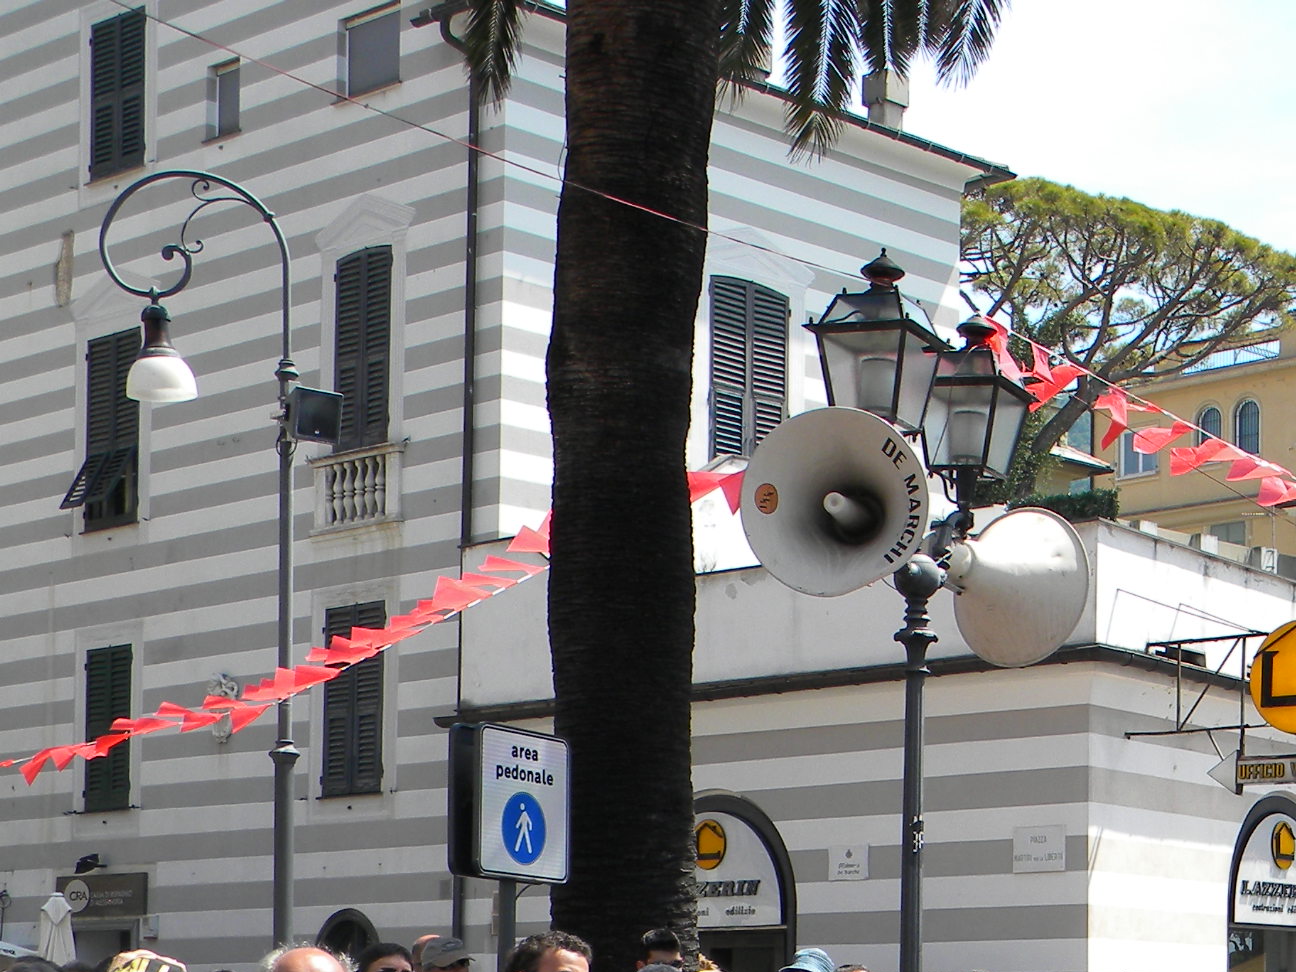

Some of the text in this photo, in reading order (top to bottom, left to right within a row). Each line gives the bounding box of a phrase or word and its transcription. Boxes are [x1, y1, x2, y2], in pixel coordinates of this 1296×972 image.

[882, 437, 921, 564] DE MARCHI
[511, 744, 539, 762] area
[496, 764, 554, 786] pedonale
[1238, 763, 1285, 780] UFFICIO
[69, 891, 88, 901] CRA
